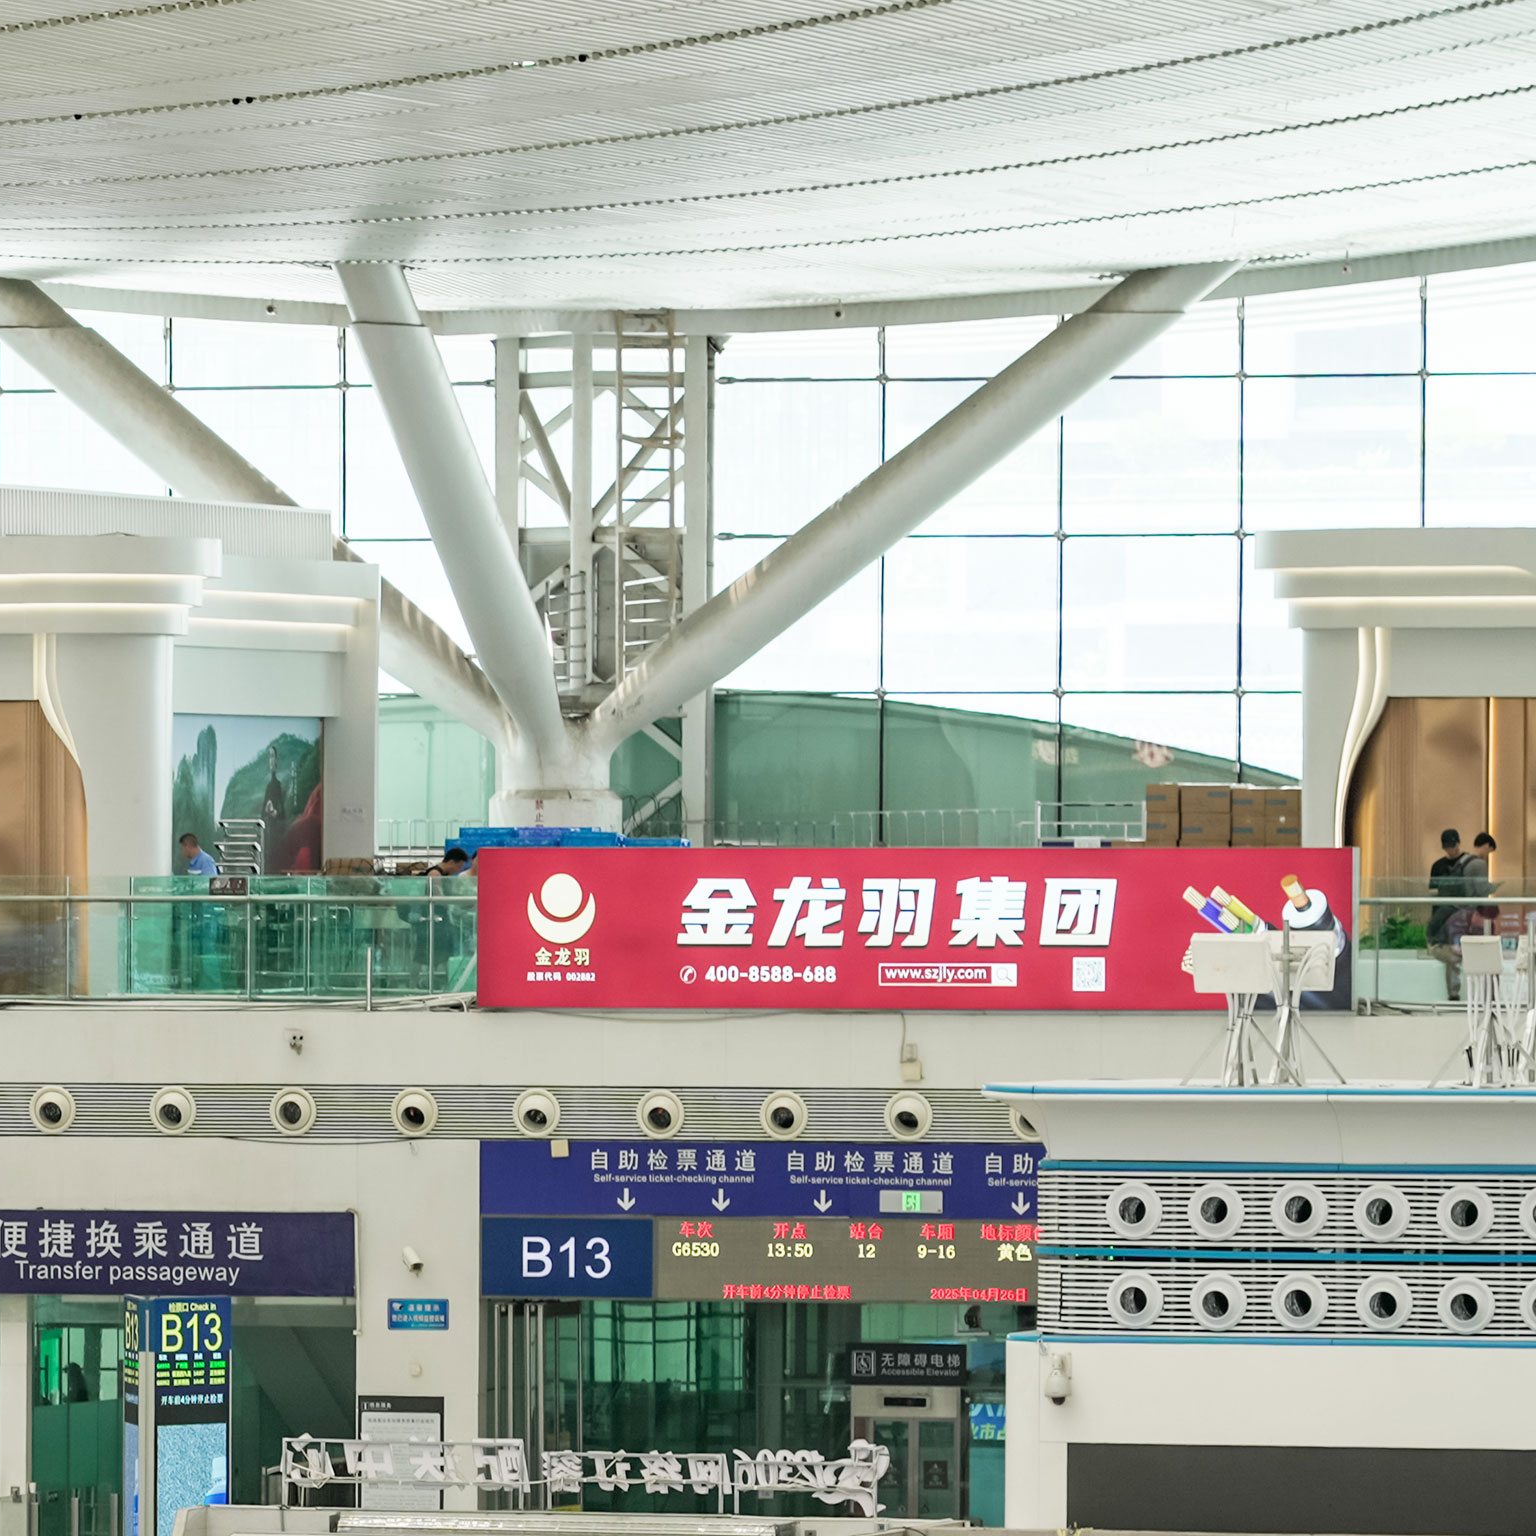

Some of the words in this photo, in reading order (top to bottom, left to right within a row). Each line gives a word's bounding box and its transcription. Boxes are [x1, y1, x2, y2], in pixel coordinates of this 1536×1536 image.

[677, 876, 1118, 948] 金龙羽集团
[534, 947, 591, 966] 金龙羽
[526, 971, 562, 982] 股票代码
[566, 972, 596, 982] 002882
[704, 965, 837, 984] 400-8588-688
[885, 966, 987, 982] www.szjly.com
[591, 1150, 757, 1173] 自助检票通道
[787, 1151, 955, 1174] 自助检票通道
[593, 1173, 646, 1184] Self-service
[649, 1173, 717, 1185] ticket-checking
[718, 1173, 755, 1184] channel
[789, 1174, 844, 1185] Self-service
[845, 1175, 914, 1186] ticket-checking
[915, 1175, 953, 1186] channel
[679, 1221, 714, 1239] 车次
[773, 1221, 808, 1239] 开点
[849, 1222, 884, 1240] 站台
[920, 1223, 956, 1240] 车厢
[521, 1237, 613, 1280] B13
[672, 1242, 720, 1257] G6530
[766, 1243, 814, 1258] 13:50
[857, 1243, 877, 1259] 12
[917, 1244, 956, 1259] 9-16
[997, 1244, 1033, 1262] 黄色
[14, 1259, 105, 1282] Transfer
[108, 1261, 241, 1287] passageway
[722, 1284, 852, 1300] 开车前4分钟停止检票
[930, 1287, 1028, 1302] 2025年04月26日
[161, 1313, 223, 1352] B13
[880, 1352, 962, 1369] 无障碍电梯
[880, 1367, 924, 1377] Accessible
[926, 1367, 961, 1377] Elevator
